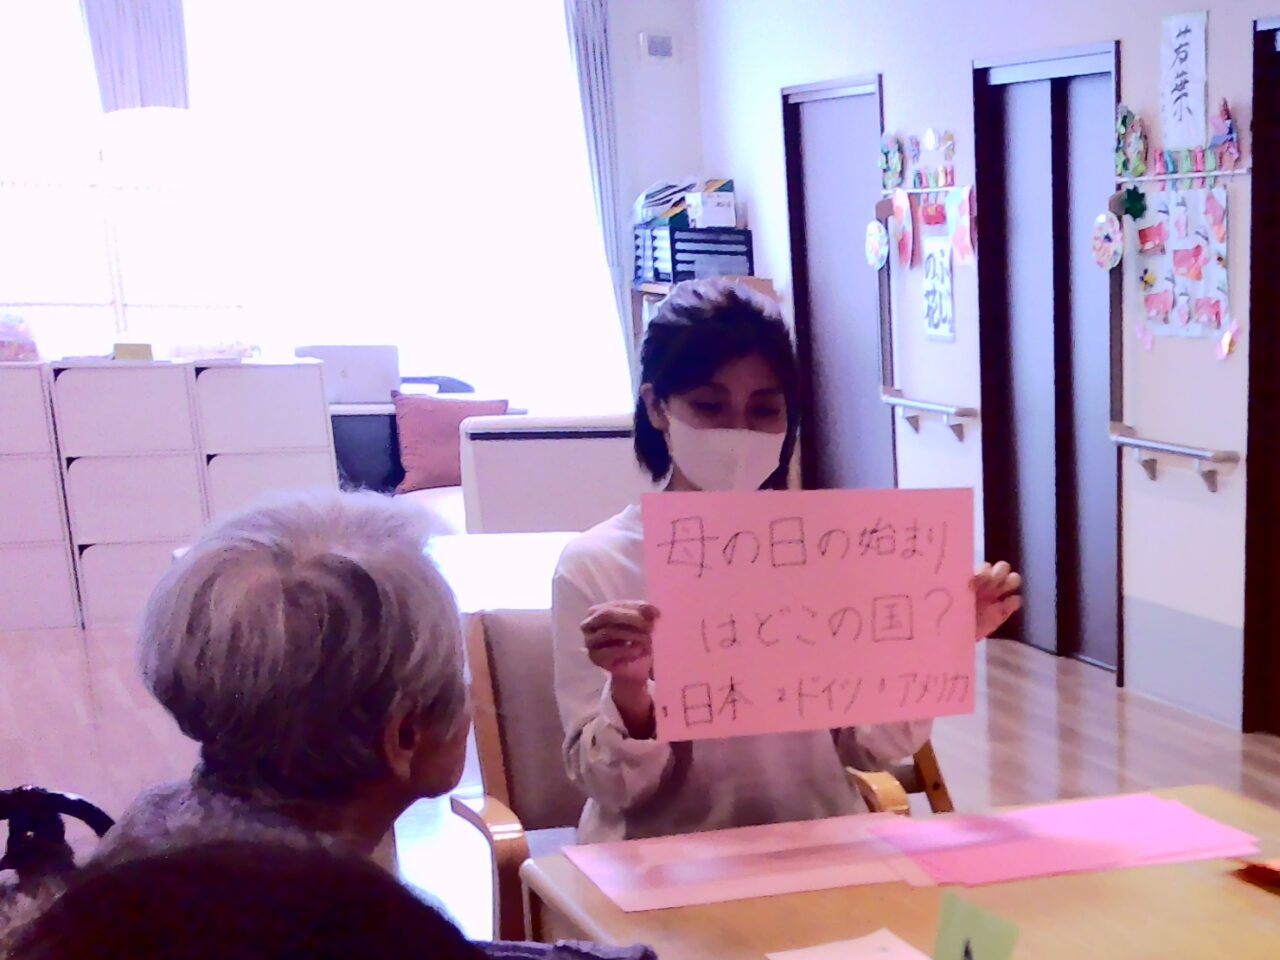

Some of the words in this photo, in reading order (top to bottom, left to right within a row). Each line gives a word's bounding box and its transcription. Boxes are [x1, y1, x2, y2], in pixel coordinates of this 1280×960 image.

[1170, 24, 1195, 122] 若葉
[656, 515, 948, 578] 母の日の始まり
